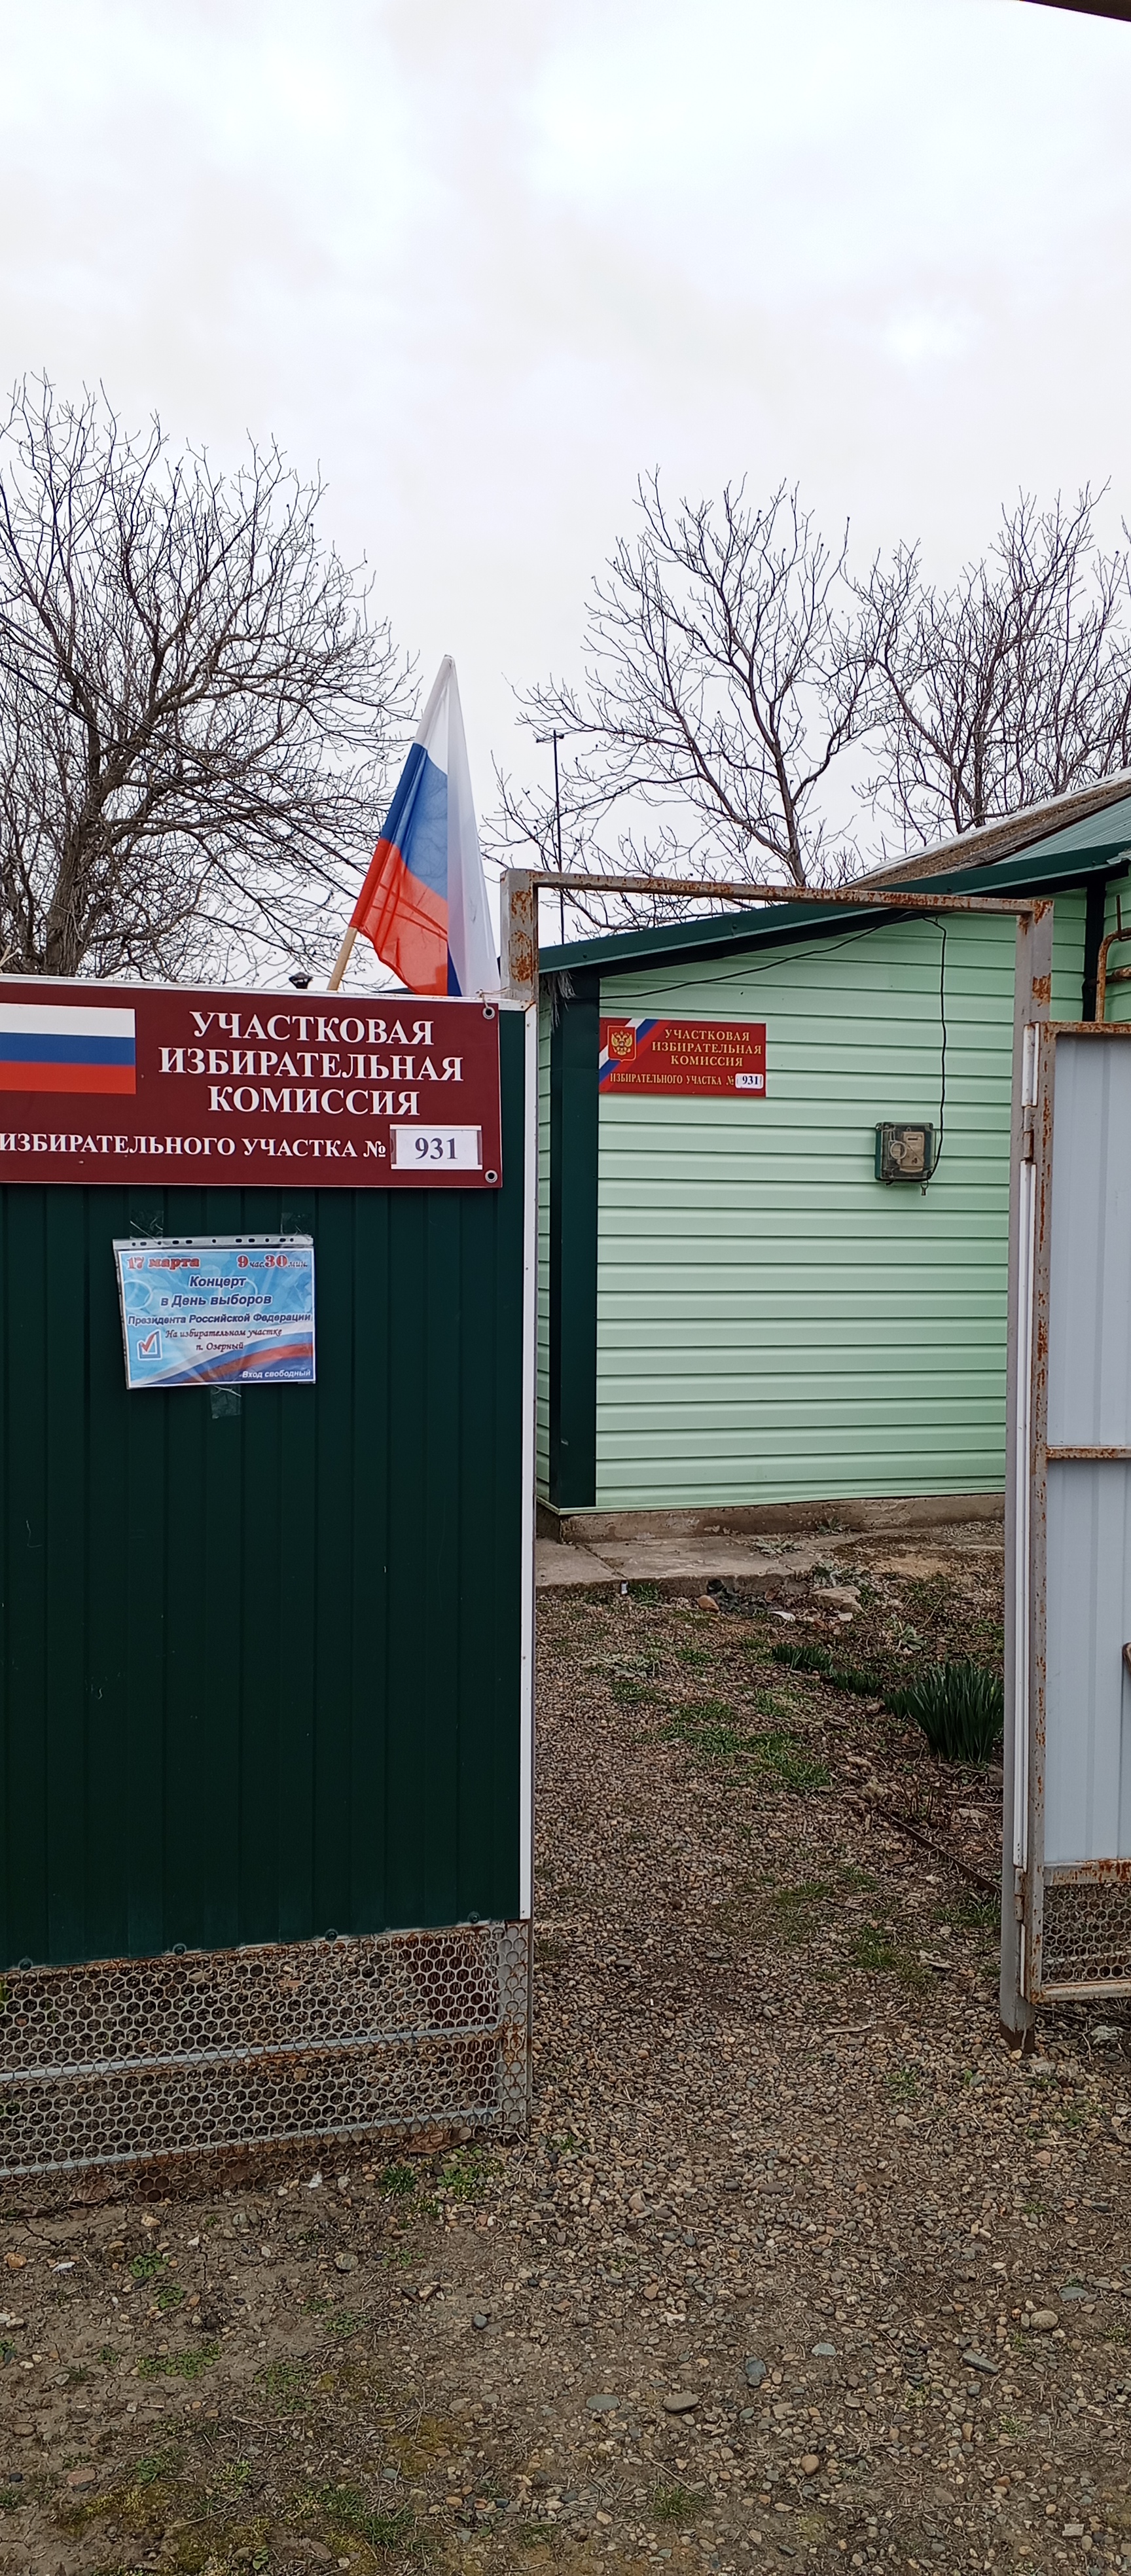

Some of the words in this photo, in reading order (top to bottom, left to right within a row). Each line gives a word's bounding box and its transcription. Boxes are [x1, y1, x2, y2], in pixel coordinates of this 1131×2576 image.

[190, 1011, 434, 1046] УЧАСТКОВАЯ
[664, 1029, 749, 1041] УЧАСТКОВАЯ
[652, 1041, 762, 1054] ИЗБИРАТЕЛЬНАЯ
[158, 1047, 463, 1082] ИЗБИРАТЕЛЬНАЯ
[670, 1055, 743, 1067] КОМИССИЯ
[610, 1073, 683, 1084] ИЗБИРАТЕЛЬНОГО
[686, 1075, 722, 1086] УЧАСТКА
[726, 1075, 734, 1086] №
[742, 1075, 759, 1086] 931
[207, 1086, 420, 1116] КОМИССИЯ
[0, 1133, 236, 1156] ИЗБИРАТЕЛЬНОГО
[243, 1138, 357, 1158] УЧАСТКА
[363, 1141, 387, 1158] №
[414, 1137, 458, 1160] 931
[126, 1257, 144, 1270] 17
[149, 1258, 200, 1270] марта
[237, 1255, 249, 1268] 9
[264, 1254, 288, 1268] 30
[189, 1276, 246, 1288] Концерт
[171, 1295, 206, 1308] День
[210, 1293, 272, 1306] выборов
[128, 1316, 186, 1325] Президента
[188, 1314, 250, 1324] Российской
[253, 1312, 312, 1322] Федерации
[165, 1330, 177, 1338] На
[179, 1328, 247, 1338] избирательном
[247, 1327, 282, 1338] участке
[206, 1342, 243, 1352] Озерный
[242, 1370, 262, 1379] Вход
[264, 1369, 311, 1378] свободный
